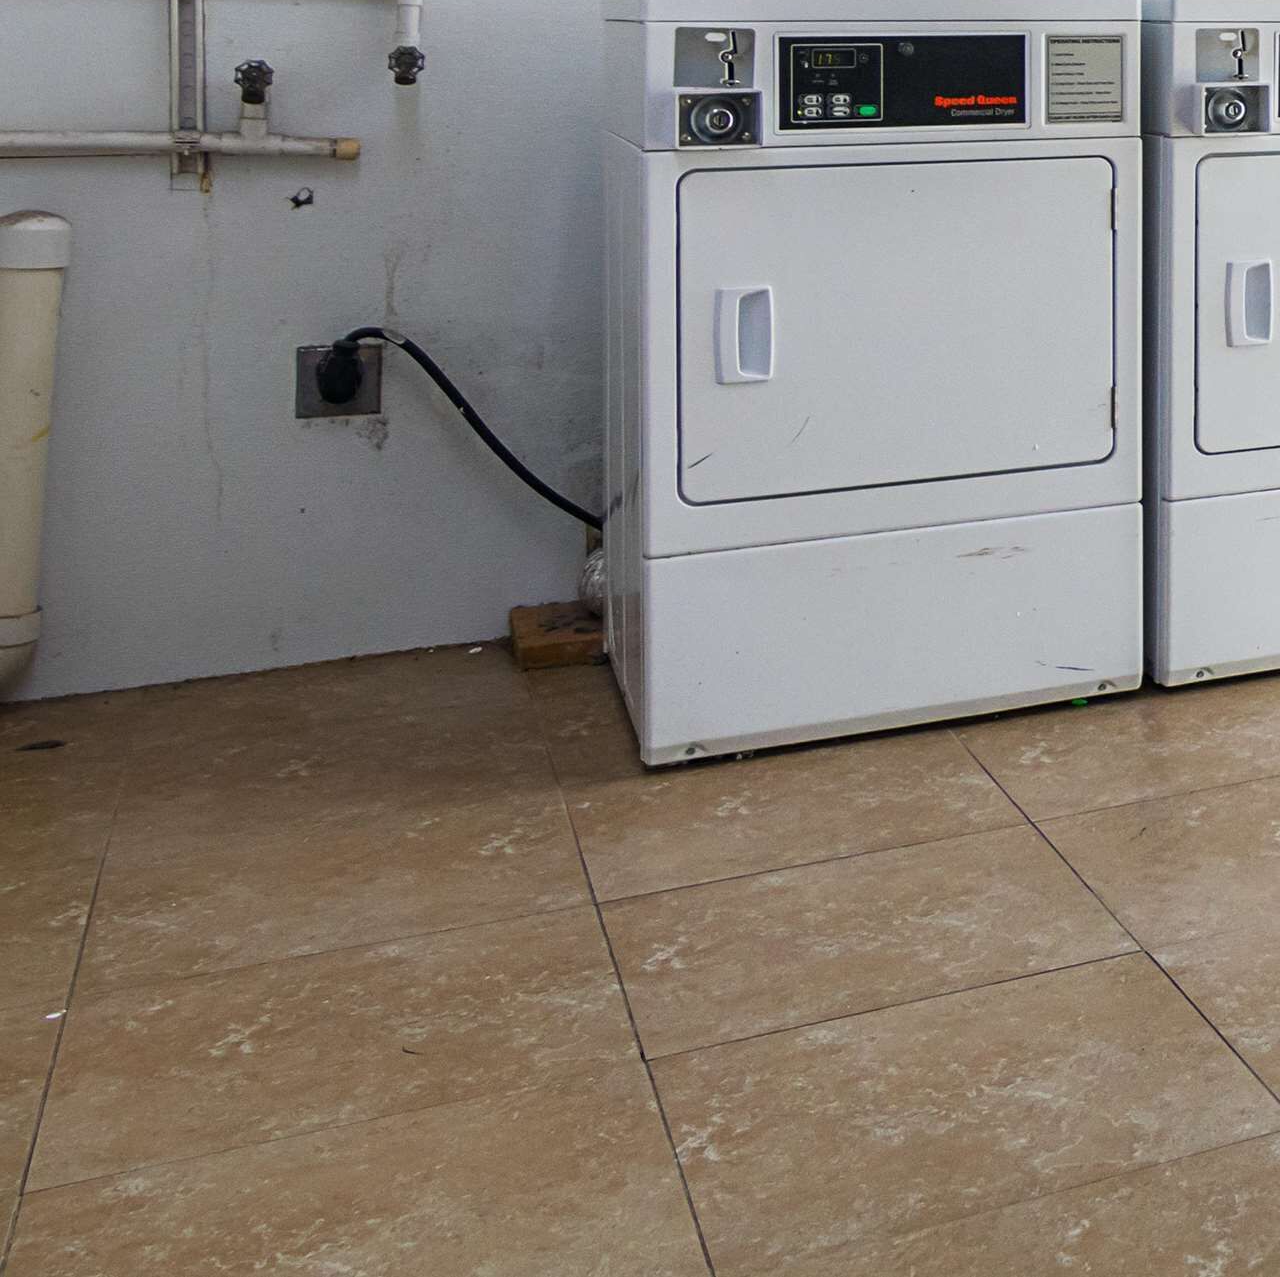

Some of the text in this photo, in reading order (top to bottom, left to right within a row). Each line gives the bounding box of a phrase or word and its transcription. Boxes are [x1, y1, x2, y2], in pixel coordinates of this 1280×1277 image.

[935, 94, 1017, 108] Speed Queen
[995, 108, 1015, 117] Dryer
